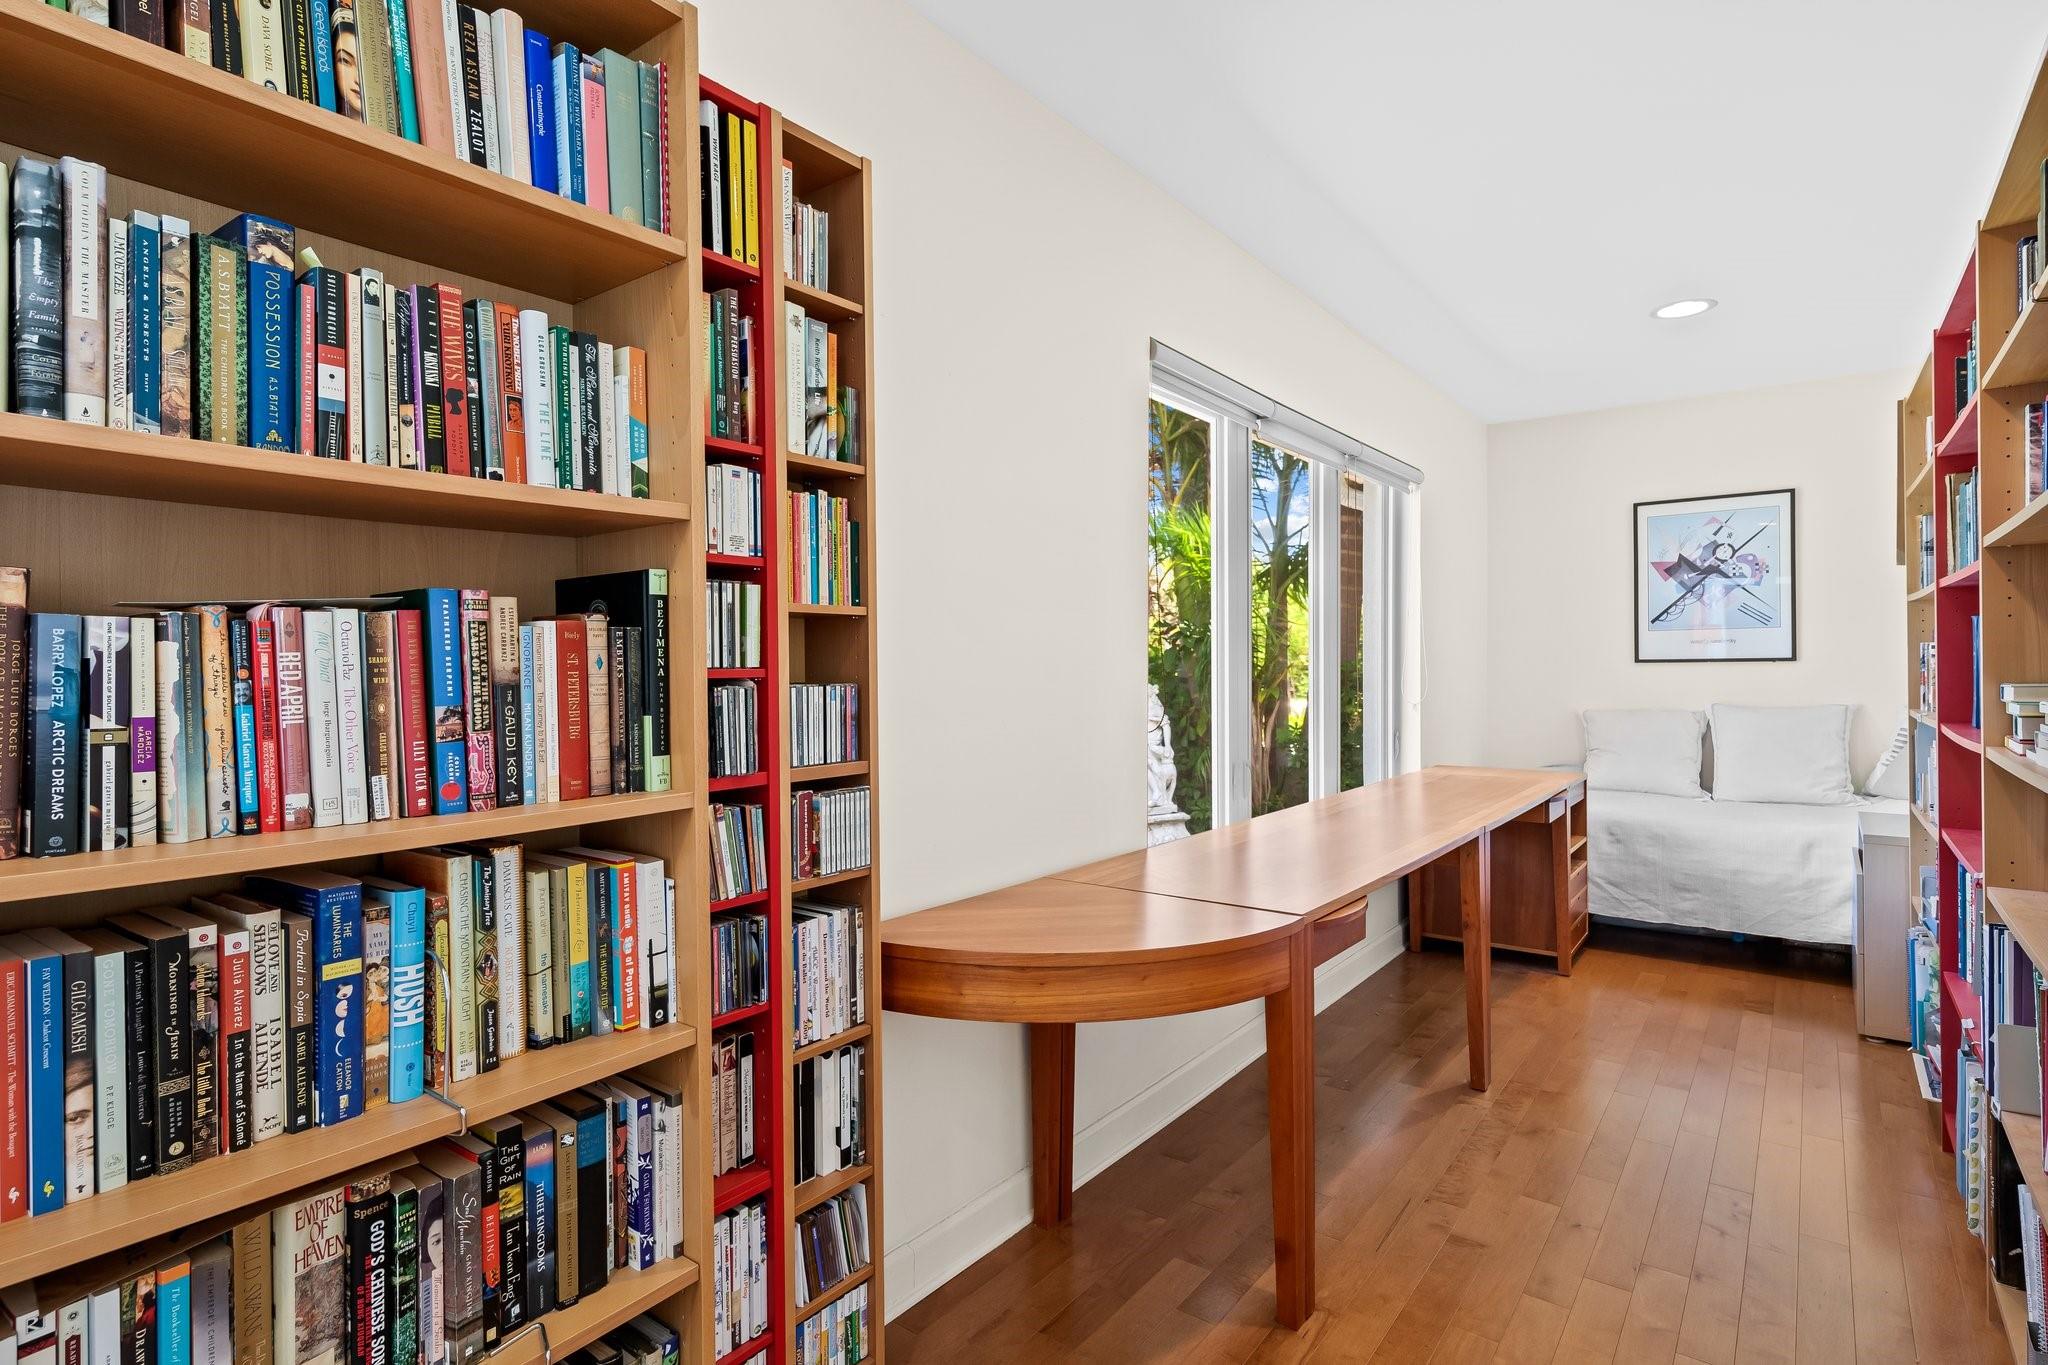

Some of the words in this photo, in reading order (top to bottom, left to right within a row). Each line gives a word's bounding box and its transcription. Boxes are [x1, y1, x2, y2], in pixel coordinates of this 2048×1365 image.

[262, 16, 273, 40] DAVA
[296, 4, 304, 23] CITY
[315, 1, 328, 37] Greek
[297, 25, 305, 36] OF
[463, 22, 476, 53] REZA
[264, 43, 274, 72] SOBEL
[298, 38, 308, 70] FALLING
[317, 37, 330, 73] Islands
[572, 53, 580, 85] SAILING
[301, 73, 310, 103] ANGELS
[466, 59, 480, 99] ASLAN
[536, 84, 546, 136] Constantinople
[470, 109, 485, 154] ZEALOT
[783, 169, 792, 211] SWANN'S
[784, 212, 792, 233] WAY
[35, 276, 55, 287] The
[29, 293, 59, 308] Empty
[219, 283, 231, 332] BYATT
[442, 299, 461, 333] THE
[730, 296, 738, 309] THE
[28, 310, 62, 325] Family
[265, 270, 281, 369] POSSESSION
[502, 321, 511, 345] YURI
[730, 312, 738, 326] ART
[443, 336, 464, 382] WIVES
[465, 324, 475, 372] SOLARIS
[730, 335, 739, 380] PERSUASION
[503, 346, 514, 390] KROTKOV
[269, 394, 279, 424] BYATT
[426, 404, 442, 440] PINBALL
[442, 599, 452, 651] FEATHERED
[10, 639, 21, 675] JORGE
[52, 628, 65, 669] BARRY
[340, 620, 354, 663] Octavio
[535, 632, 544, 662] Hermann
[616, 631, 624, 678] EMBERS
[279, 652, 302, 679] RED
[341, 663, 354, 681] Paz
[523, 631, 532, 690] IGNORANCE
[536, 664, 544, 683] Hesse
[566, 652, 579, 668] ST.
[9, 679, 21, 706] LUIS
[51, 671, 64, 707] LOPEZ
[106, 686, 113, 694] OF
[445, 656, 454, 697] SERPENT
[280, 684, 305, 728] APRIL
[322, 701, 332, 717] Jorge
[343, 686, 357, 708] The
[537, 692, 545, 704] The
[567, 671, 581, 739] PETERSBURG
[345, 710, 358, 743] Other
[504, 705, 517, 751] GAUDI
[524, 703, 533, 731] MILAN
[535, 705, 545, 729] Journey
[8, 712, 20, 757] BORGES
[52, 720, 65, 765] ARCTIC
[323, 719, 333, 767] Ibarguengoitia
[412, 740, 426, 761] LILY
[538, 738, 546, 749] the
[345, 744, 359, 773] Voice
[506, 757, 518, 786] KEY
[524, 735, 533, 778] KUNDERA
[538, 750, 546, 763] East
[51, 769, 65, 820] DREAMS
[414, 766, 428, 792] TUCK
[502, 860, 513, 910] DAMASCUS
[269, 922, 279, 936] OF
[332, 905, 343, 959] LUMINARIES
[343, 923, 352, 938] THE
[407, 902, 418, 934] Chayil
[504, 913, 513, 937] GATE
[254, 924, 267, 996] SHADOWS
[268, 936, 281, 971] LOVE
[294, 929, 310, 973] Portrait
[504, 948, 514, 980] ROBERT
[541, 953, 549, 966] the
[41, 967, 51, 981] FAY
[232, 958, 245, 984] Julia
[270, 974, 279, 992] AND
[297, 976, 307, 986] in
[41, 982, 51, 1015] WELDON
[233, 989, 245, 1028] Alvarez
[294, 991, 310, 1022] Sepia
[393, 962, 425, 1027] HUSH
[505, 984, 514, 1015] STONE
[541, 972, 550, 1015] namesake
[41, 1019, 51, 1041] Chalcot
[70, 980, 87, 1053] GILGAMESH
[41, 1042, 51, 1069] Crescent
[233, 1038, 245, 1048] In
[254, 1022, 268, 1093] ALLENDE
[269, 1016, 282, 1090] ISABEL
[296, 1031, 306, 1064] ISABEL
[234, 1052, 245, 1068] the
[344, 1057, 352, 1091] ELEANOR
[234, 1071, 245, 1096] Name
[296, 1065, 306, 1108] ALLENDE
[335, 1062, 344, 1091] CATTON
[235, 1099, 246, 1109] of
[235, 1111, 247, 1145] Salomé
[500, 1155, 520, 1166] GIFT
[501, 1144, 520, 1156] THE
[499, 1172, 521, 1185] RAIN
[504, 1166, 517, 1174] OF
[295, 1191, 344, 1232] EMPIRE
[536, 1181, 545, 1215] THREE
[309, 1218, 328, 1243] OF
[370, 1220, 385, 1267] GOD'S
[486, 1215, 495, 1261] BEIJING
[506, 1222, 519, 1245] Tan
[536, 1216, 546, 1272] KINGDOMS
[243, 1225, 262, 1281] WILD
[294, 1234, 344, 1274] HEAVEN
[506, 1247, 520, 1274] Twan
[170, 1286, 181, 1302] The
[370, 1268, 385, 1337] CHINESE
[501, 1275, 520, 1302] Eng
[243, 1285, 263, 1337] SWANS
[170, 1305, 180, 1352] Bookseller
[170, 1355, 180, 1363] of
